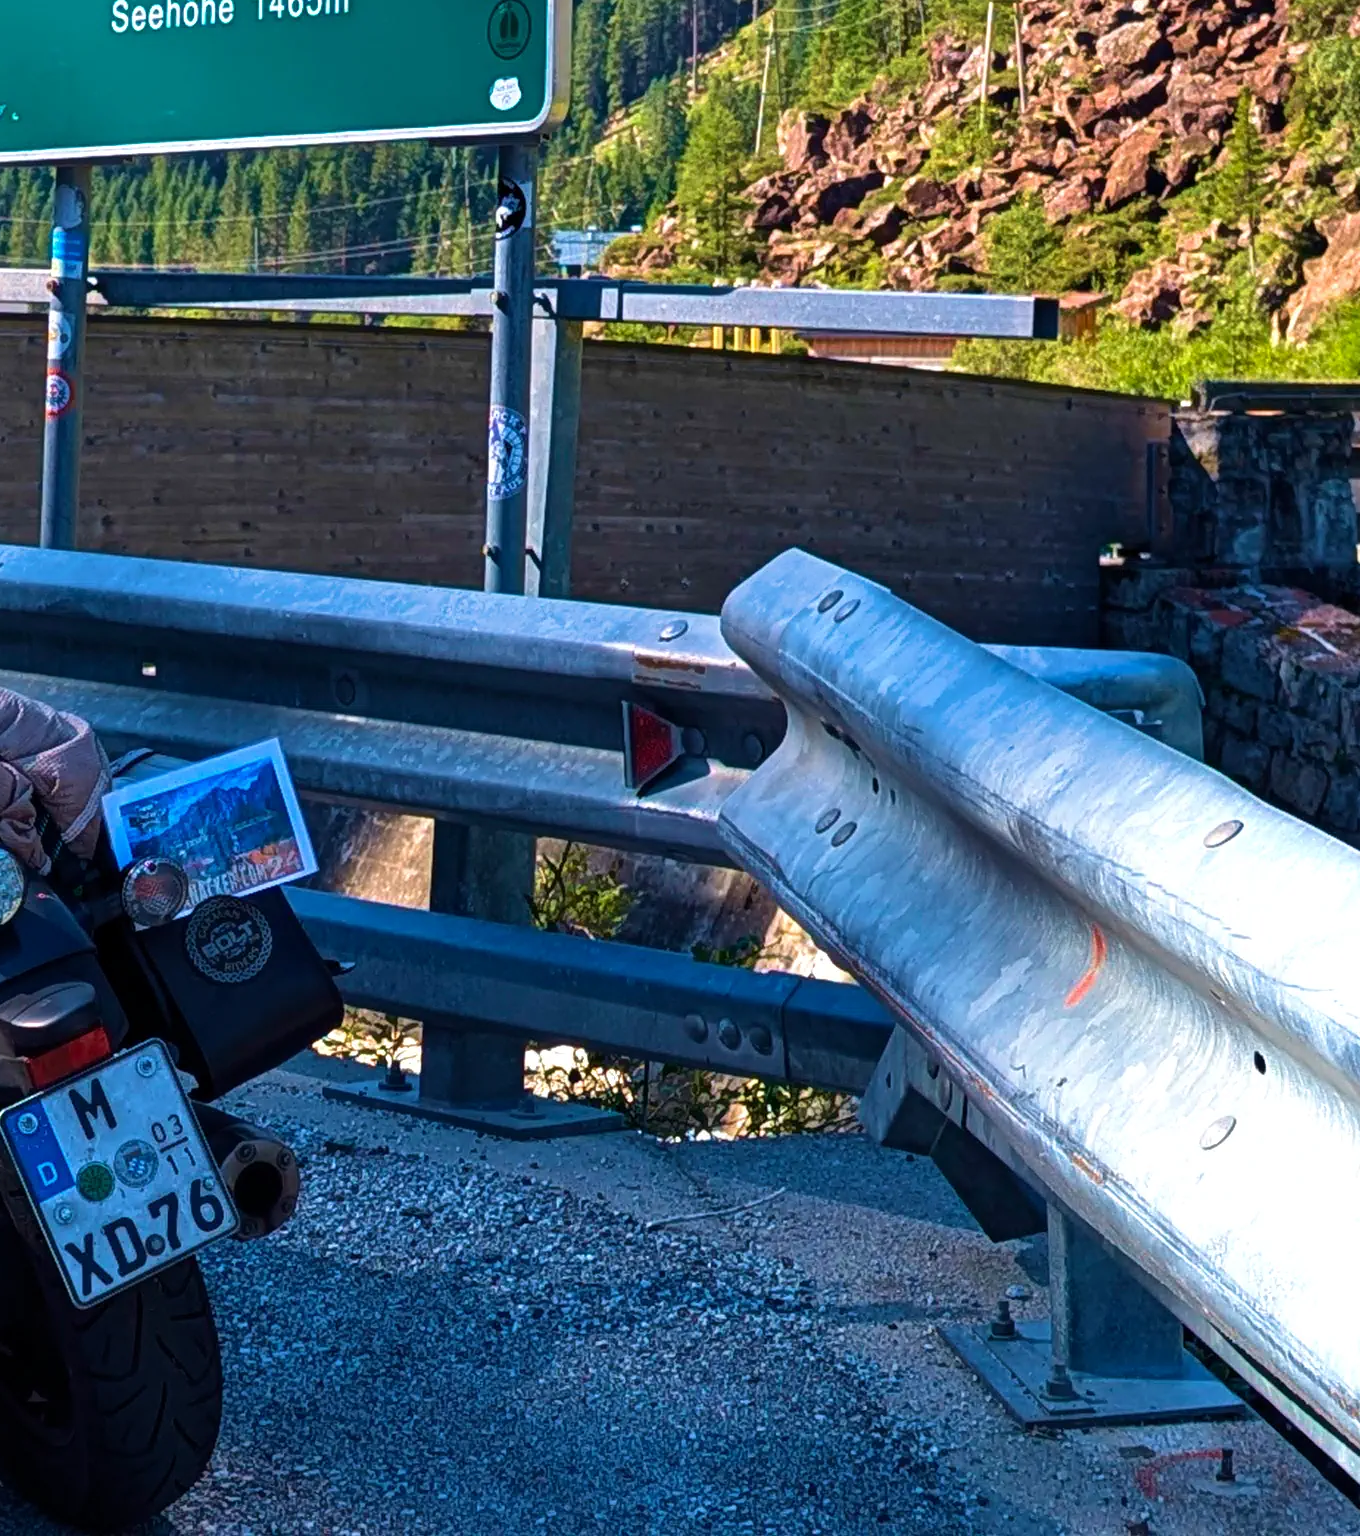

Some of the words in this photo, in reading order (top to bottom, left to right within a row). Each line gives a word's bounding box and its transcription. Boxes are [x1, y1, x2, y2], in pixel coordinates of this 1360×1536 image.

[200, 920, 253, 958] BOLT
[67, 1077, 118, 1141] M
[151, 1113, 184, 1144] 03
[36, 1161, 59, 1188] D
[165, 1147, 197, 1176] 11
[64, 1215, 148, 1297] XD
[147, 1178, 225, 1251] 76
